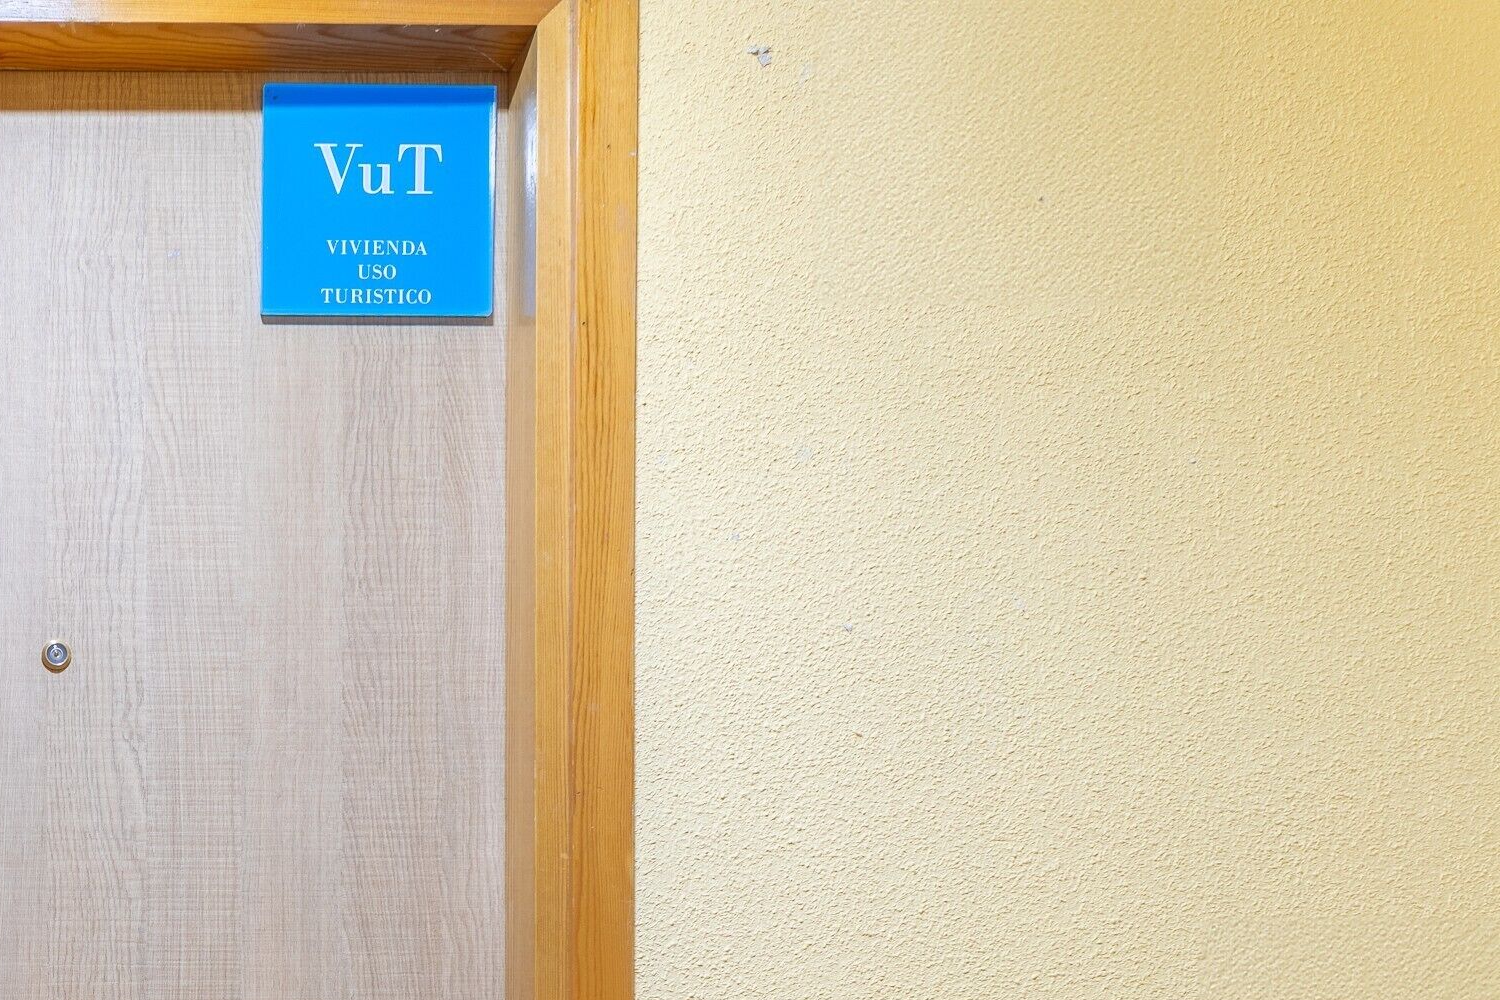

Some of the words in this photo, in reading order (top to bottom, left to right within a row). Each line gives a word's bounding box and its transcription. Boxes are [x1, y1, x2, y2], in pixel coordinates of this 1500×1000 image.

[313, 143, 443, 195] VuT
[326, 239, 428, 256] VIVIENDA
[357, 264, 398, 280] USO
[320, 287, 433, 305] TURISTICO
